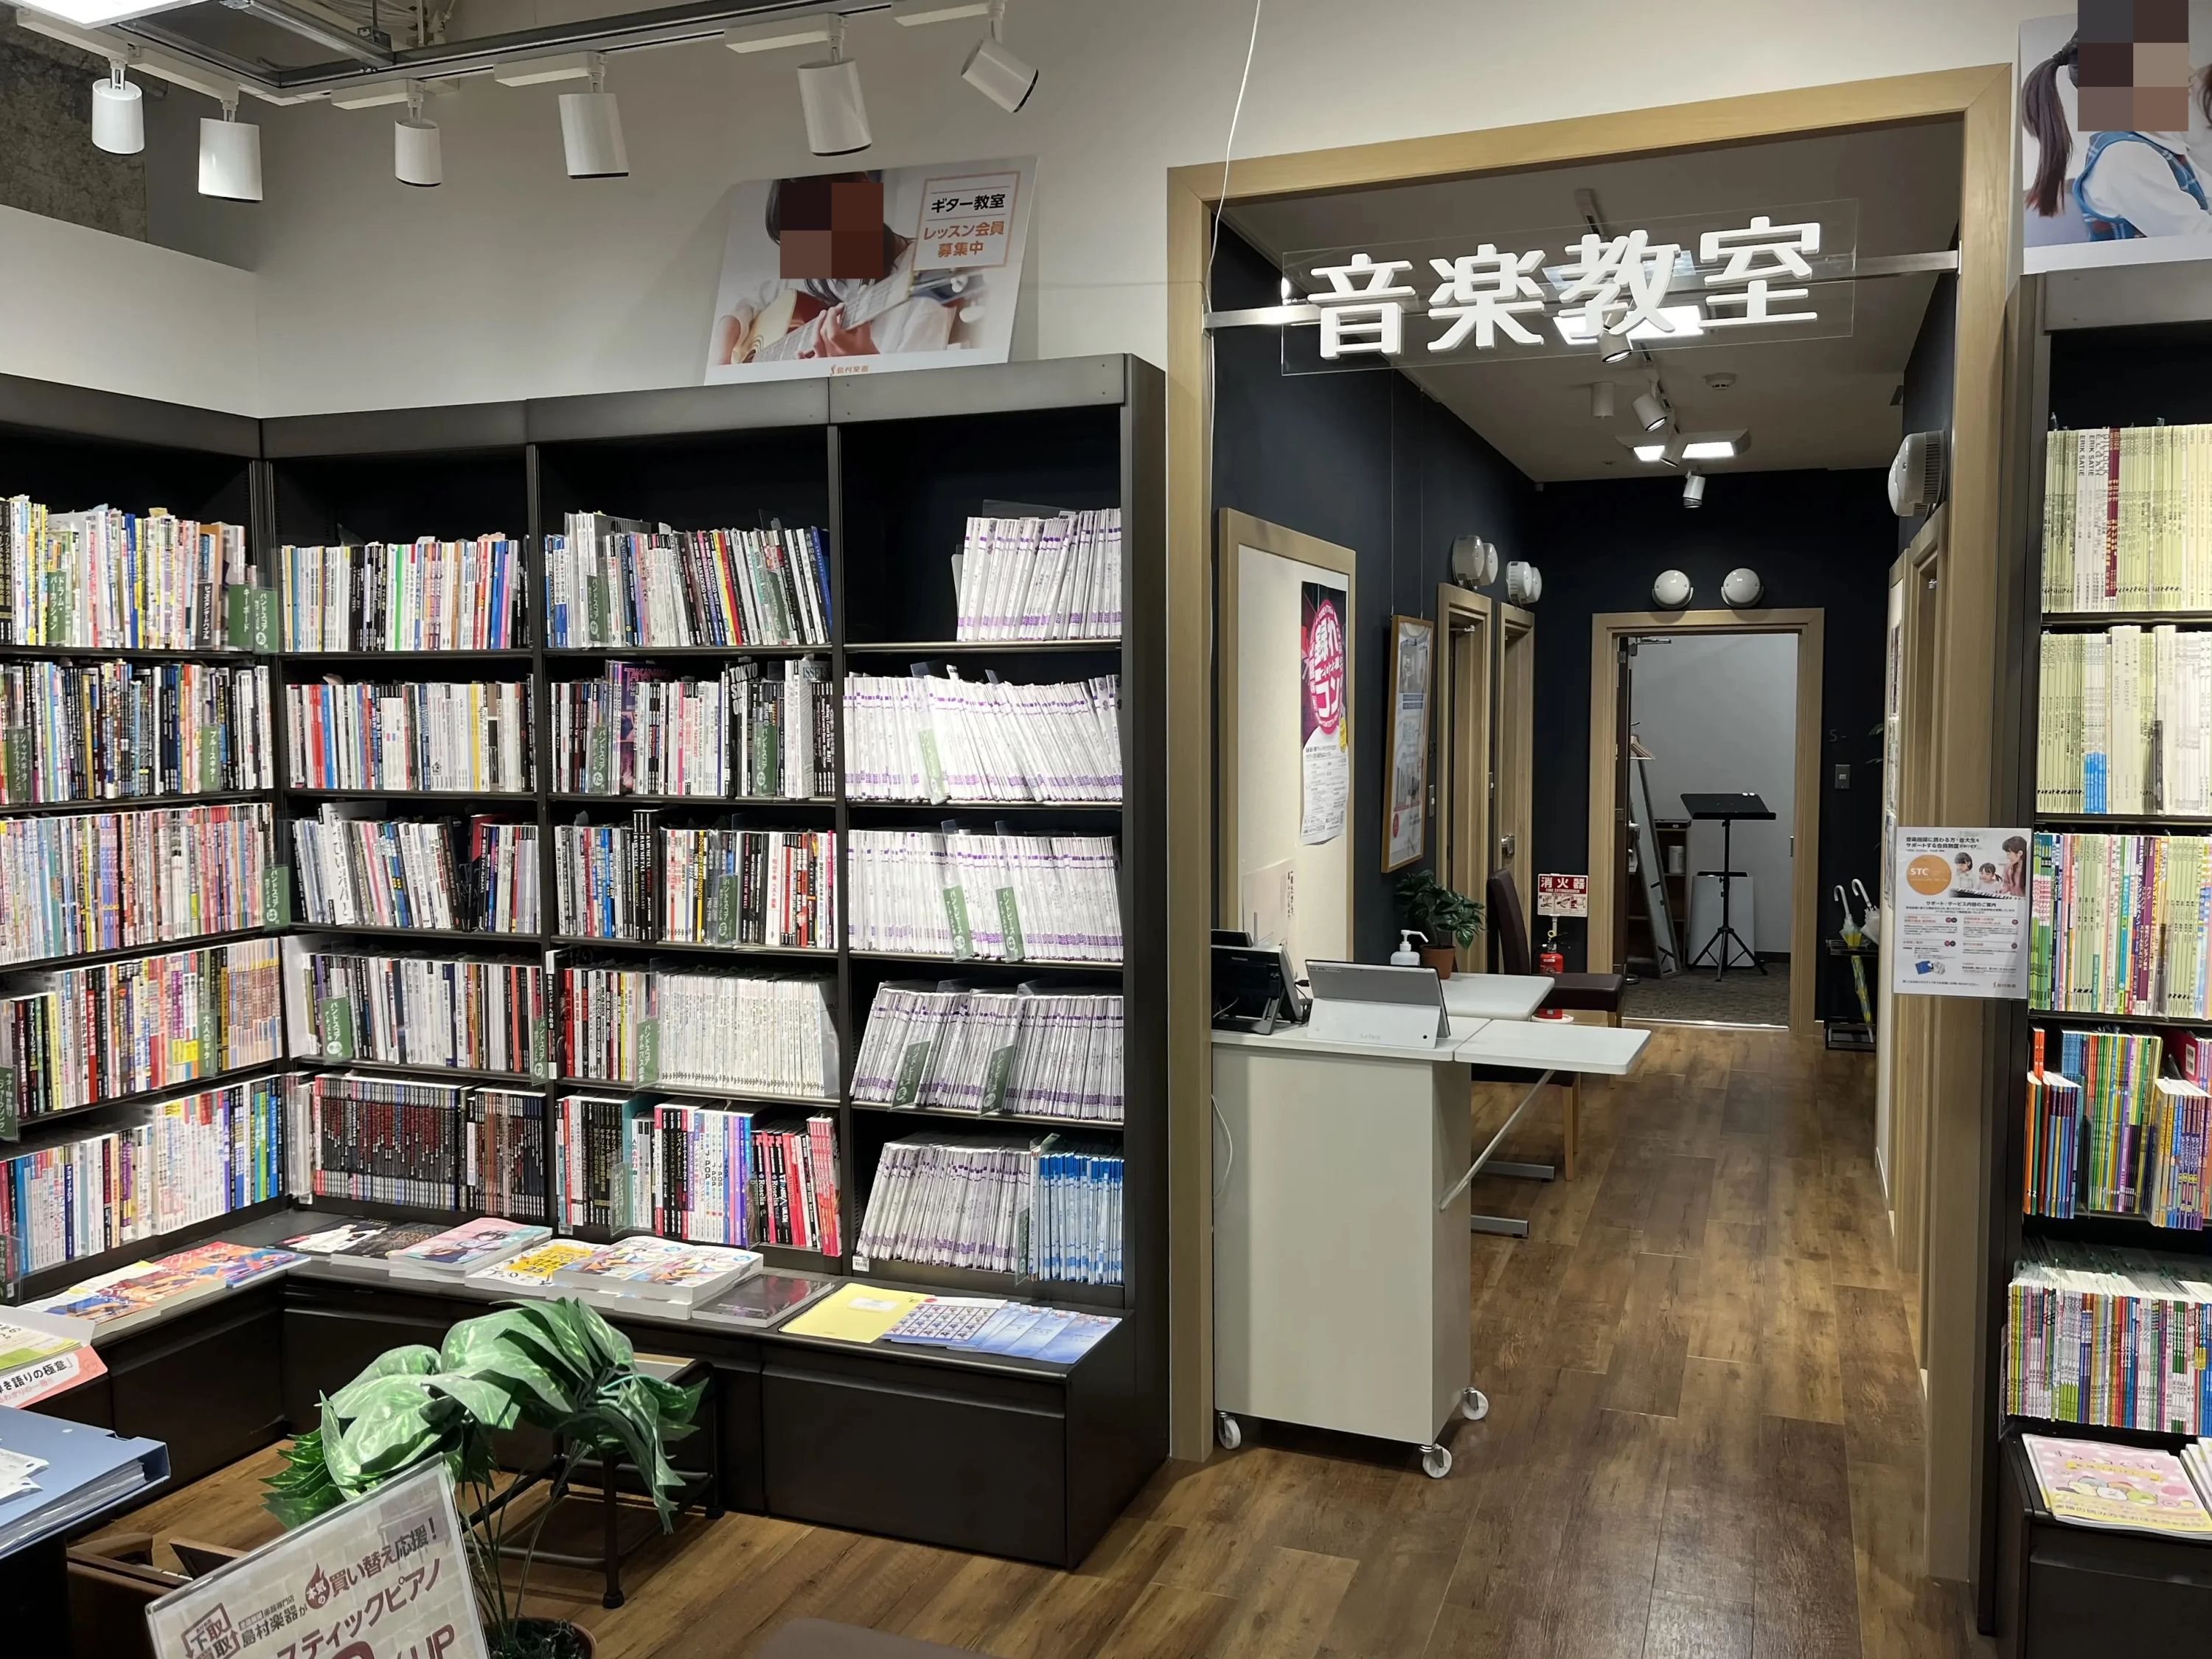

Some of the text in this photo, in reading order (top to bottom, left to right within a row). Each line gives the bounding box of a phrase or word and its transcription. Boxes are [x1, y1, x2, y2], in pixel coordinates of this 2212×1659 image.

[931, 193, 1006, 214] ギター教室
[923, 220, 1005, 240] レッスン会員
[937, 241, 984, 258] 募集中
[1307, 215, 1822, 359] 音楽教室
[243, 588, 251, 633] キーボード
[729, 662, 758, 684] TOKYO
[271, 869, 279, 908] バンドスコア
[1540, 876, 1585, 890] 消火器
[1910, 867, 1929, 876] STC
[950, 890, 963, 934] バンドピース
[1003, 890, 1015, 935] バンドピース
[331, 1002, 341, 1040] バンドスコア
[203, 1015, 211, 1068] 大人のギター
[0, 1357, 74, 1394] き語りの極意」
[241, 1603, 309, 1649] 島村楽器が
[306, 1579, 327, 1607] 本気の
[276, 1557, 441, 1659] スティックピアノ
